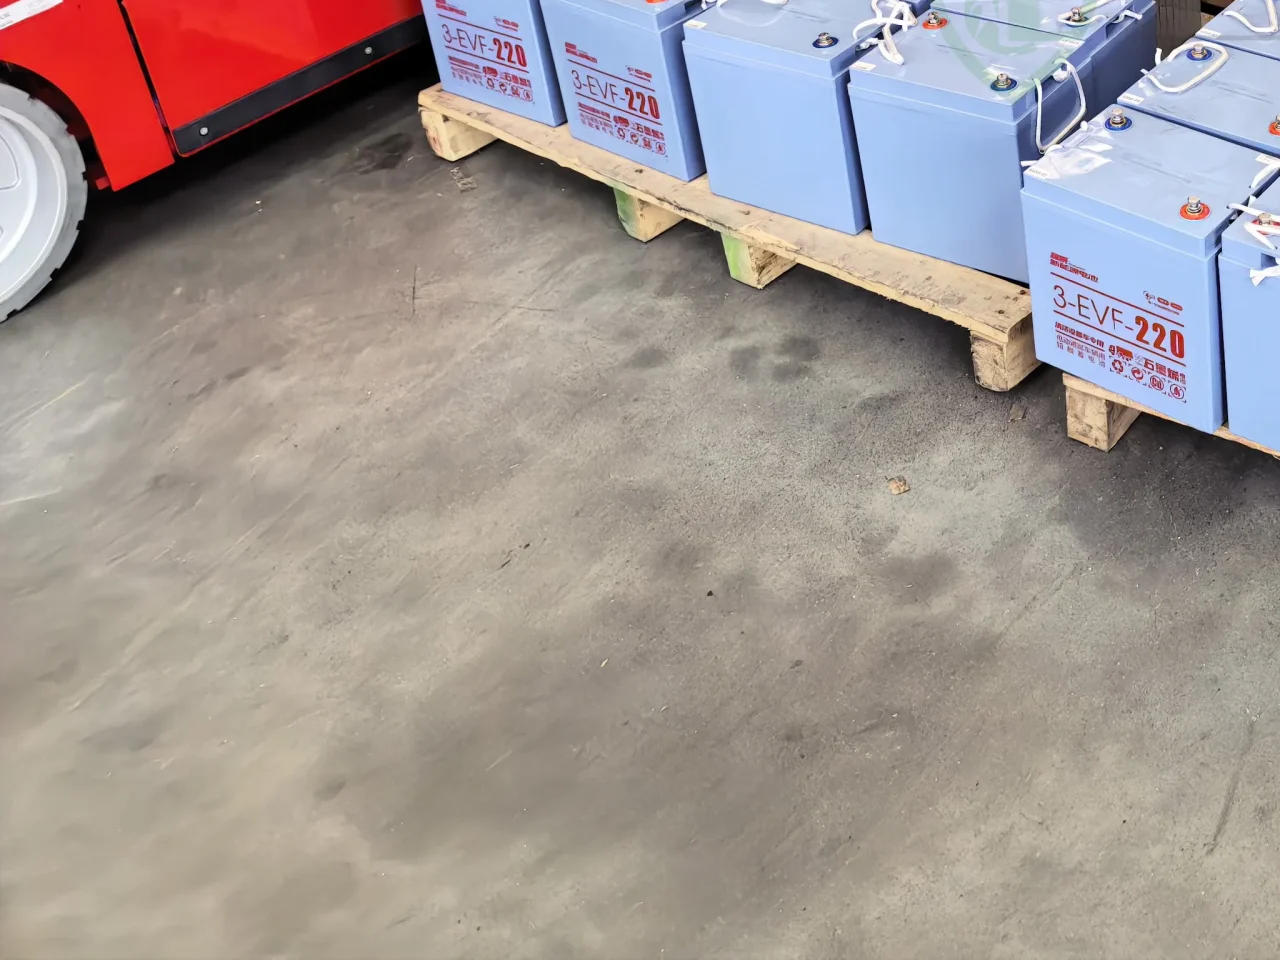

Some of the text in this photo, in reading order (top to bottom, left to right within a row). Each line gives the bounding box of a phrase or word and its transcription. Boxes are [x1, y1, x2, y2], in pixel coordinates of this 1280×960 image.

[441, 23, 527, 68] 3-EVF-220
[571, 69, 660, 120] 3-EVF-220
[1053, 284, 1185, 359] 3-EVF-220
